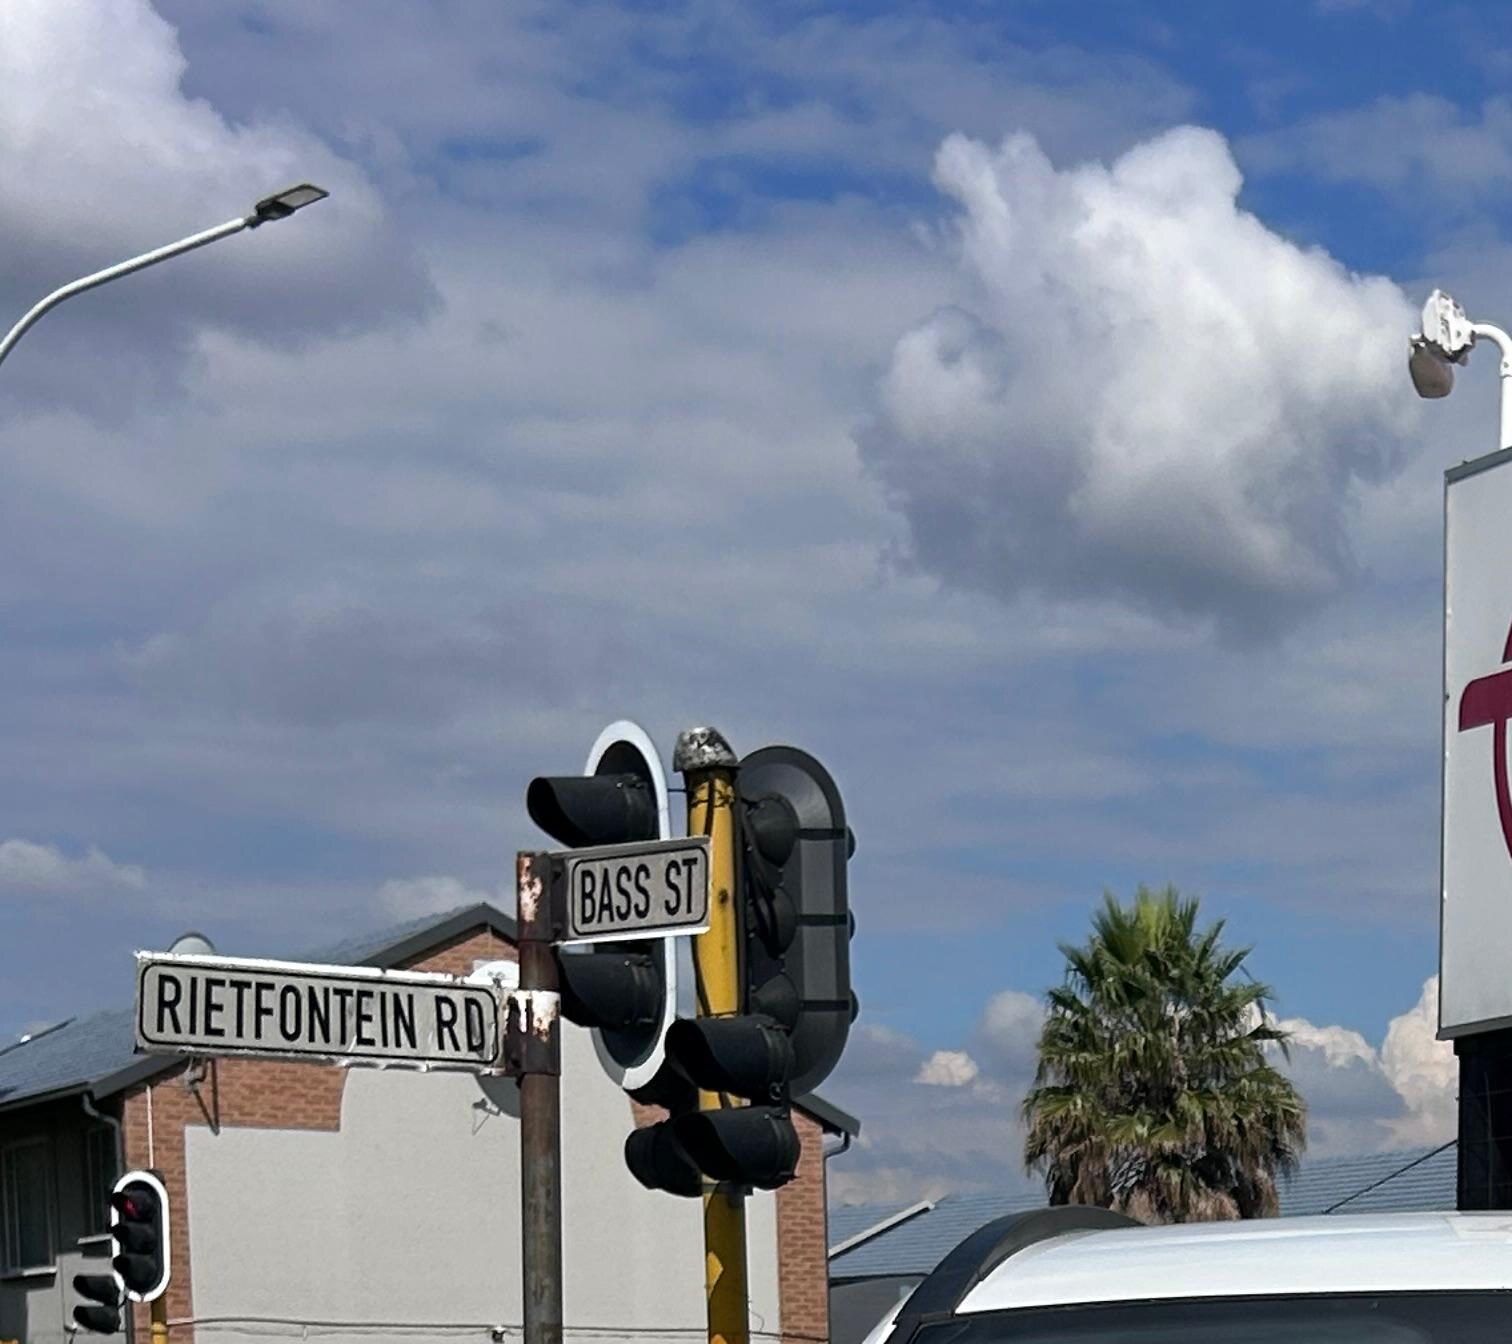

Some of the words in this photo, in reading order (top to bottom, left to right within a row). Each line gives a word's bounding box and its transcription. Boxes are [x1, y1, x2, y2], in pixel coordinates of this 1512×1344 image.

[580, 863, 651, 925] BASS
[664, 856, 699, 917] ST
[156, 972, 417, 1049] RIETFONTEIN
[434, 994, 487, 1058] RD
